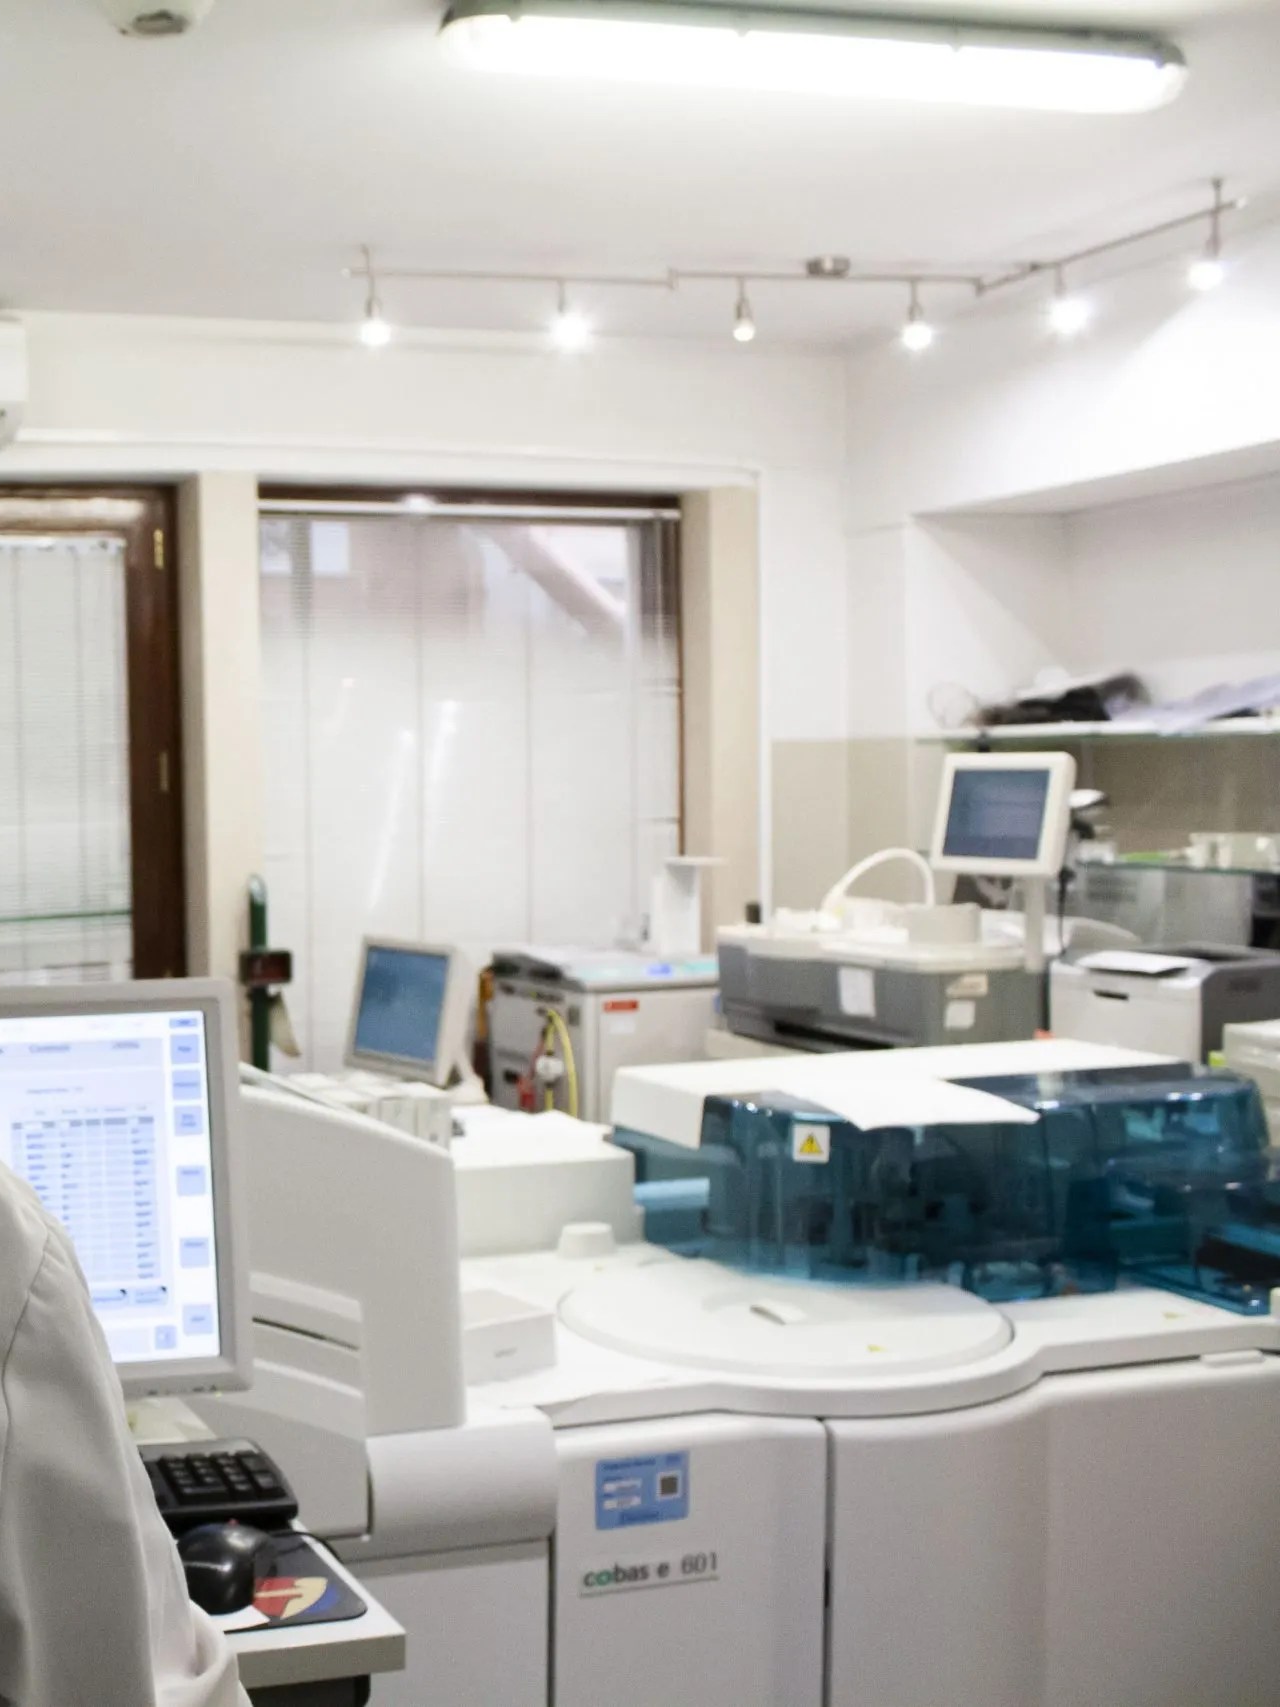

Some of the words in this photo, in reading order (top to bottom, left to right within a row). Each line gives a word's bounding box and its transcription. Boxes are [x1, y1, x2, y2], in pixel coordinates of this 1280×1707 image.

[583, 1562, 650, 1588] cobas
[657, 1561, 670, 1578] e
[680, 1551, 718, 1575] 601
